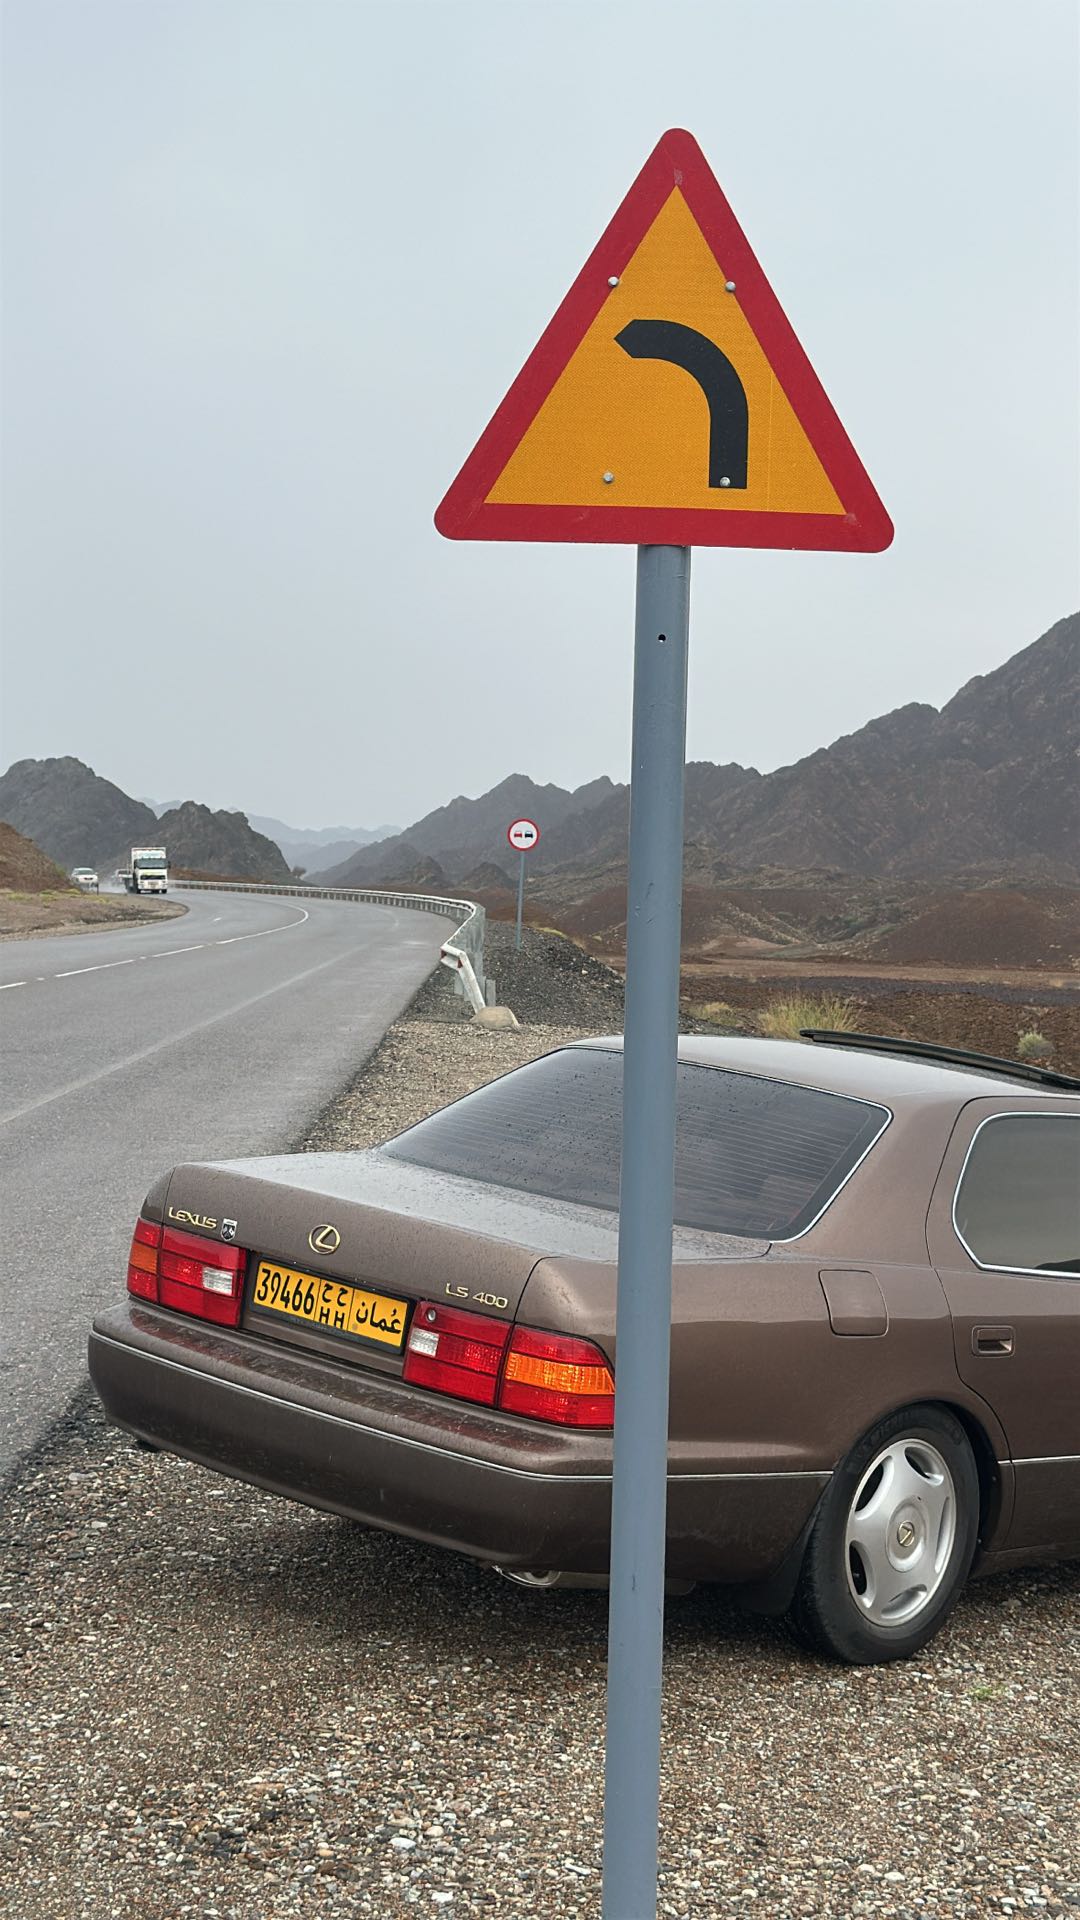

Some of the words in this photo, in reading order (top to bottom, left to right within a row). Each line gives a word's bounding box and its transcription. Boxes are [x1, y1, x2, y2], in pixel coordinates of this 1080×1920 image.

[168, 1206, 217, 1229] LEXUS
[257, 1268, 315, 1315] 39466
[445, 1282, 469, 1298] LS
[472, 1291, 508, 1309] 400
